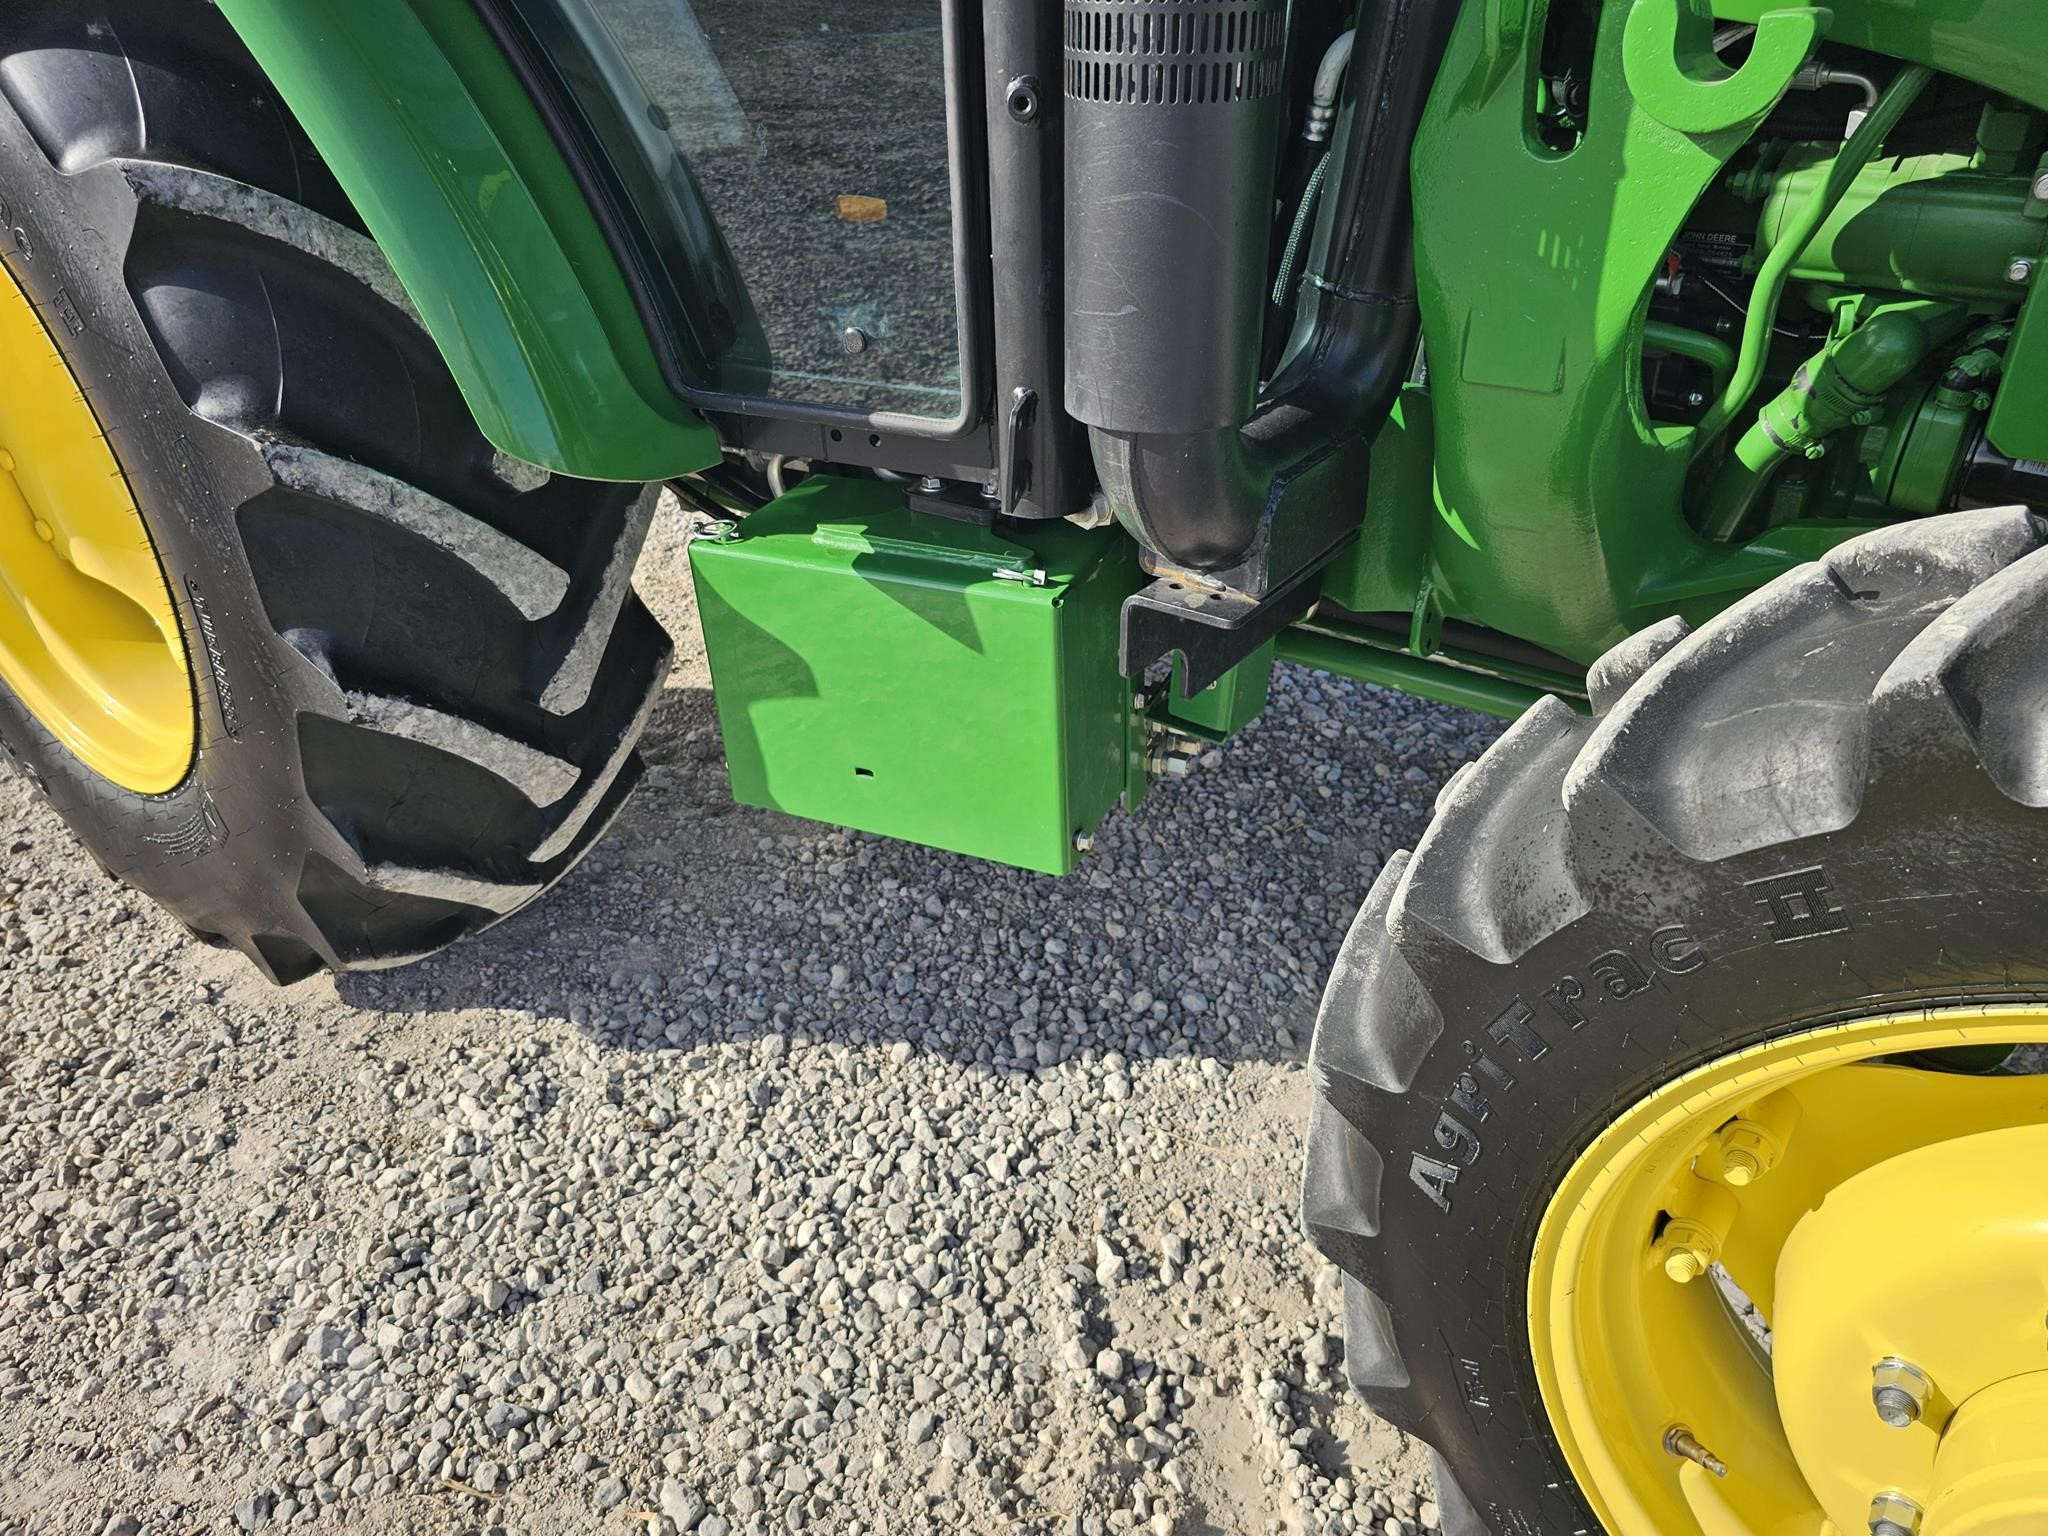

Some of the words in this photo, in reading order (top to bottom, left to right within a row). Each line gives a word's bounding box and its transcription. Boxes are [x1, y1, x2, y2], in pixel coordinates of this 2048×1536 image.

[1706, 233, 1737, 244] DEERE
[1409, 923, 1707, 1214] AgriTrac
[1743, 865, 1854, 944] II
